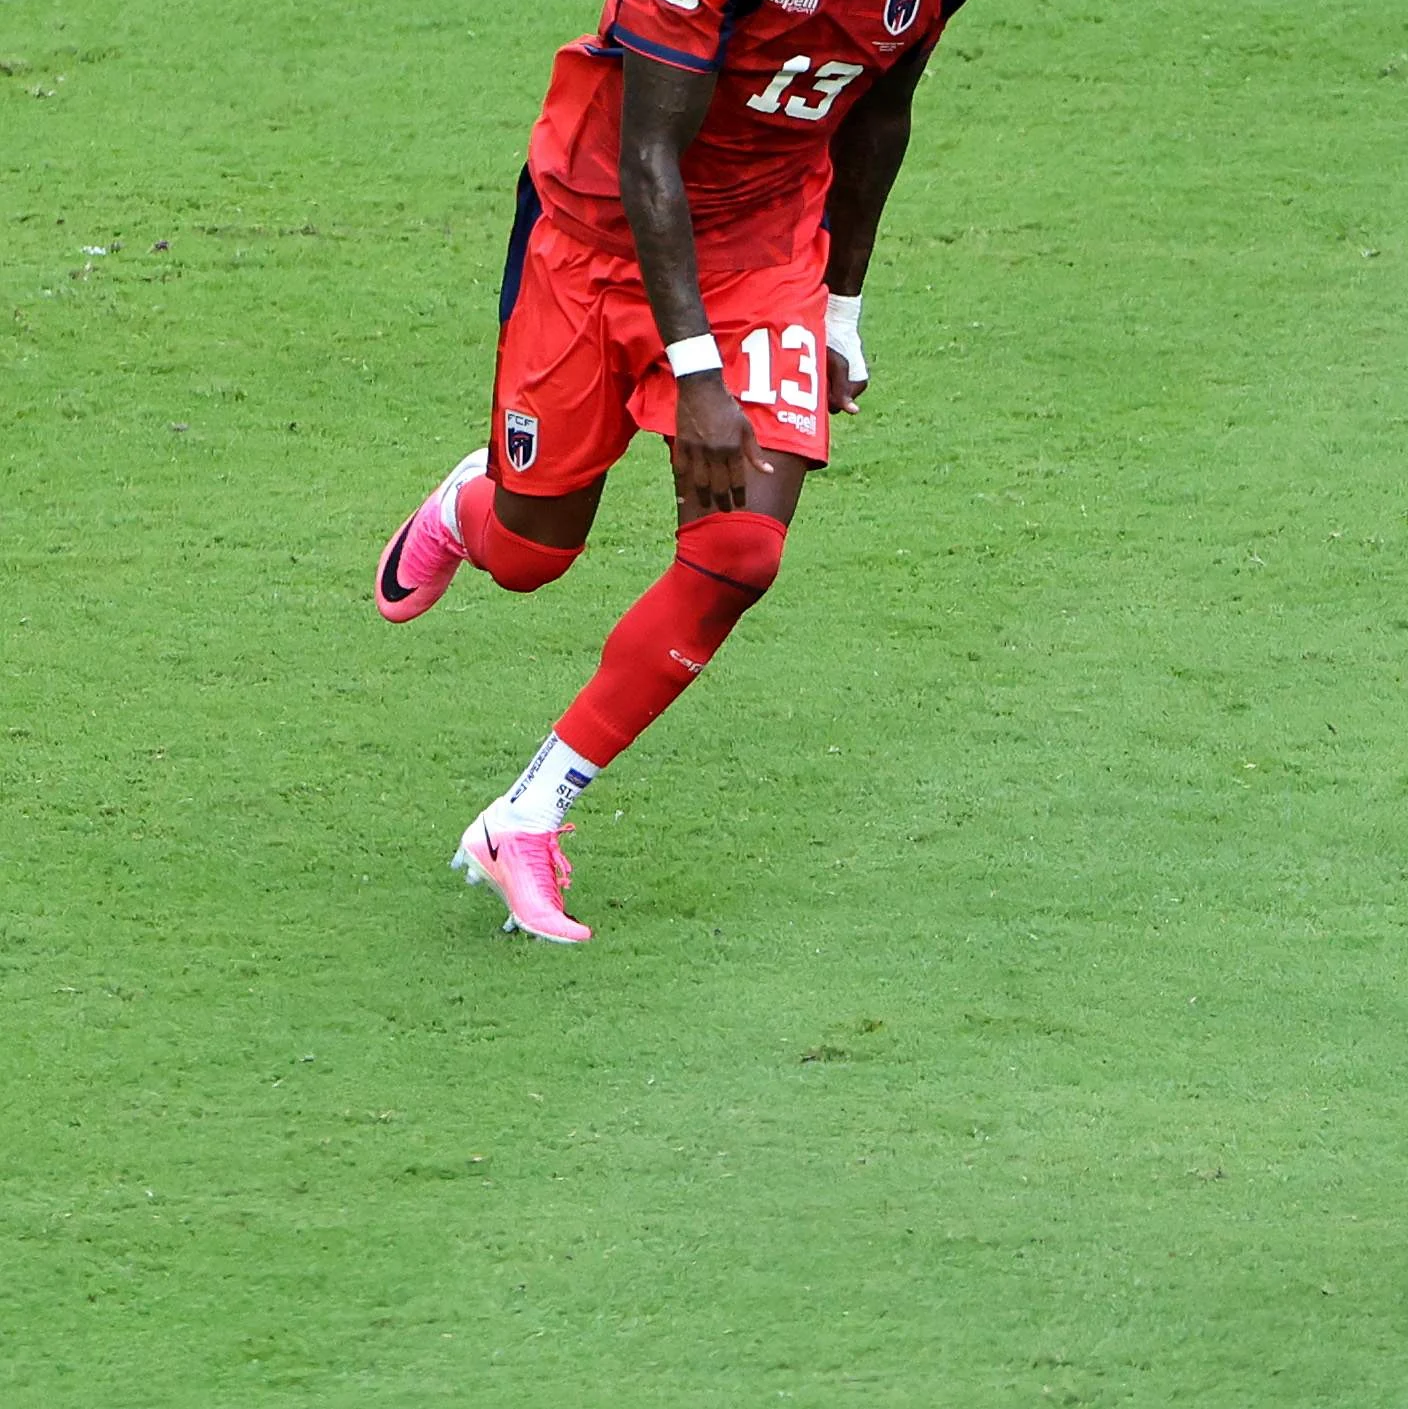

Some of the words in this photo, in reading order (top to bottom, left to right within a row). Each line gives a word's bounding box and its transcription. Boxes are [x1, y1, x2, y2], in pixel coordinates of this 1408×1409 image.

[746, 54, 865, 122] 13
[740, 324, 819, 412] 13
[507, 413, 535, 426] FCF
